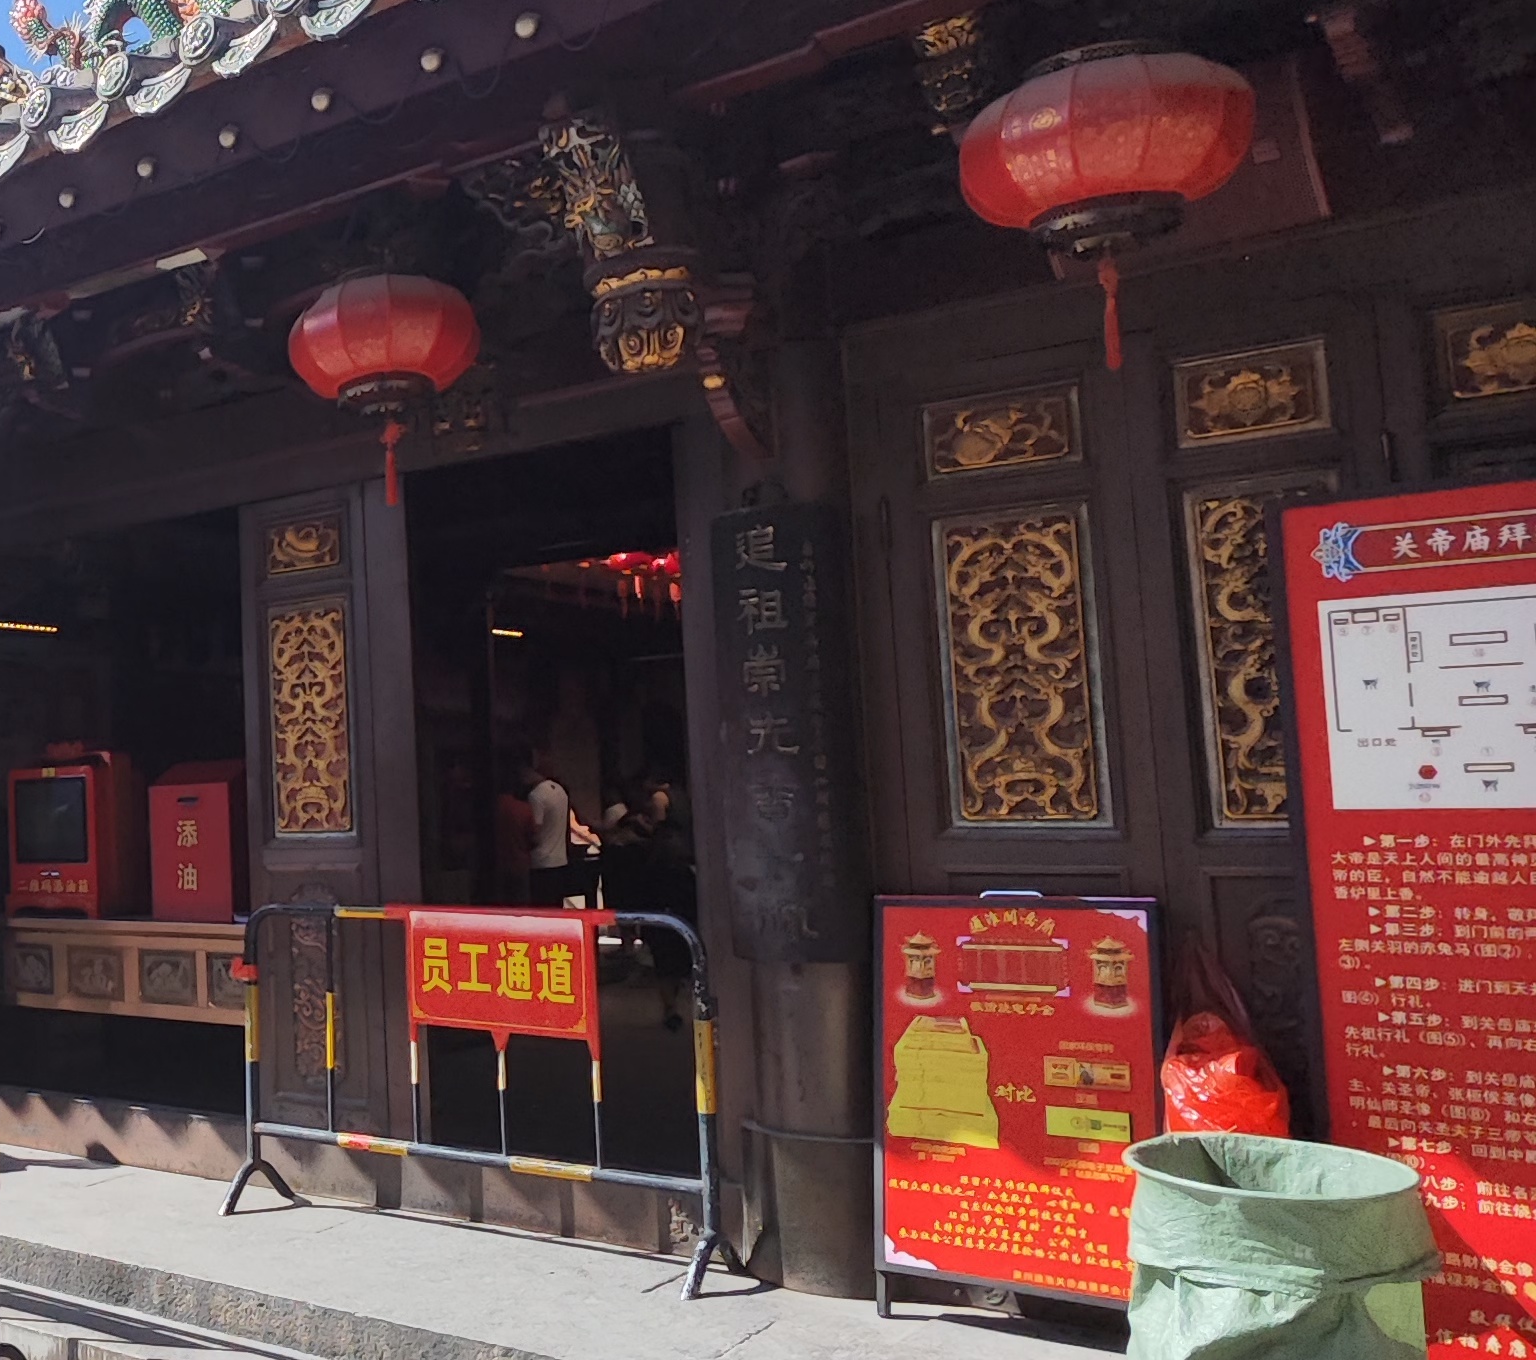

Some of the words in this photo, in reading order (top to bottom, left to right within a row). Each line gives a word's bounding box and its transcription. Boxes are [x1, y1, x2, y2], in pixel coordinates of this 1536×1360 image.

[1391, 521, 1532, 559] 关帝庙拜
[1357, 737, 1397, 748] 出口处
[176, 819, 199, 891] 添油
[421, 936, 576, 1004] 员工通道
[994, 1082, 1036, 1103] 对比
[1442, 1251, 1534, 1278] 路财神金像
